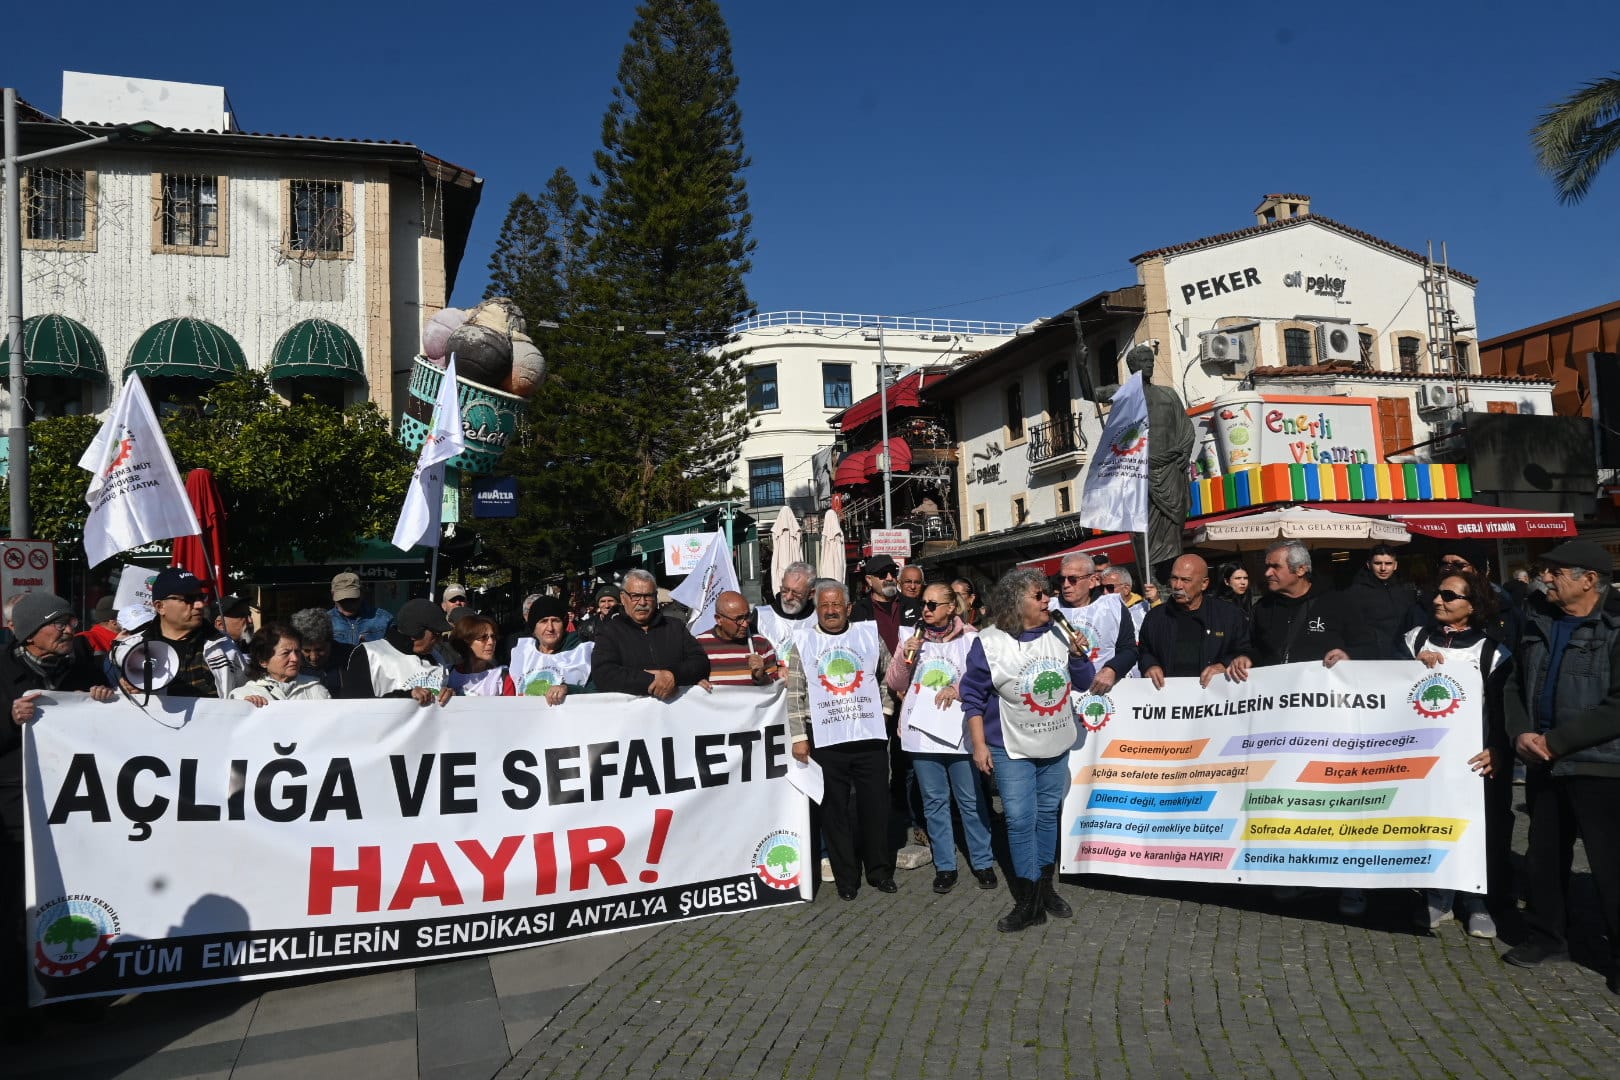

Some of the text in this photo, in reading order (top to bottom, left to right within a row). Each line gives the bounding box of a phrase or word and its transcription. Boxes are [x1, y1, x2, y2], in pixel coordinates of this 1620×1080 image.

[1181, 267, 1262, 305] PEKER
[1306, 274, 1346, 293] peker
[1224, 525, 1270, 533] GELATERIA
[1307, 523, 1362, 531] GELATERIA
[1457, 521, 1516, 534] ENERJİ VİTAMİN
[1132, 689, 1386, 720] TÜM EMEKLİLERİN SENDİKASI
[821, 714, 851, 726] ANTALYA
[1119, 743, 1193, 756] Geçinemiyoruz!
[1242, 735, 1418, 750] Bu gerici düzeni değiştireceğiz.
[1092, 766, 1249, 780] Açlığa sefalete teslim olmayacağız!
[1324, 764, 1410, 779] Bıçak kemikte.
[47, 724, 789, 842] AÇLIĞA VE SEFALETE
[1095, 793, 1202, 808] Dilenci değil, emekliyiz!
[1248, 793, 1386, 809] İntibak yasası çıkarılsın!
[1125, 822, 1149, 834] değil
[1151, 823, 1191, 834] emekliye
[1193, 823, 1224, 835] bütçe!
[1250, 823, 1453, 837] Sofrada Adalet, Ülkede Demokrasi
[308, 808, 674, 915] HAYIR!
[1130, 851, 1142, 859] ve
[1144, 850, 1187, 862] karanlığa
[1189, 851, 1224, 862] HAYIR!
[1244, 853, 1432, 868] Sendika hakkımız engellenemez!
[92, 897, 121, 936] SENDİKASI
[113, 876, 758, 978] TÜM EMEKLİLERİN SENDİKASI ANTALYA ŞUBESİ
[59, 953, 78, 961] 2017
